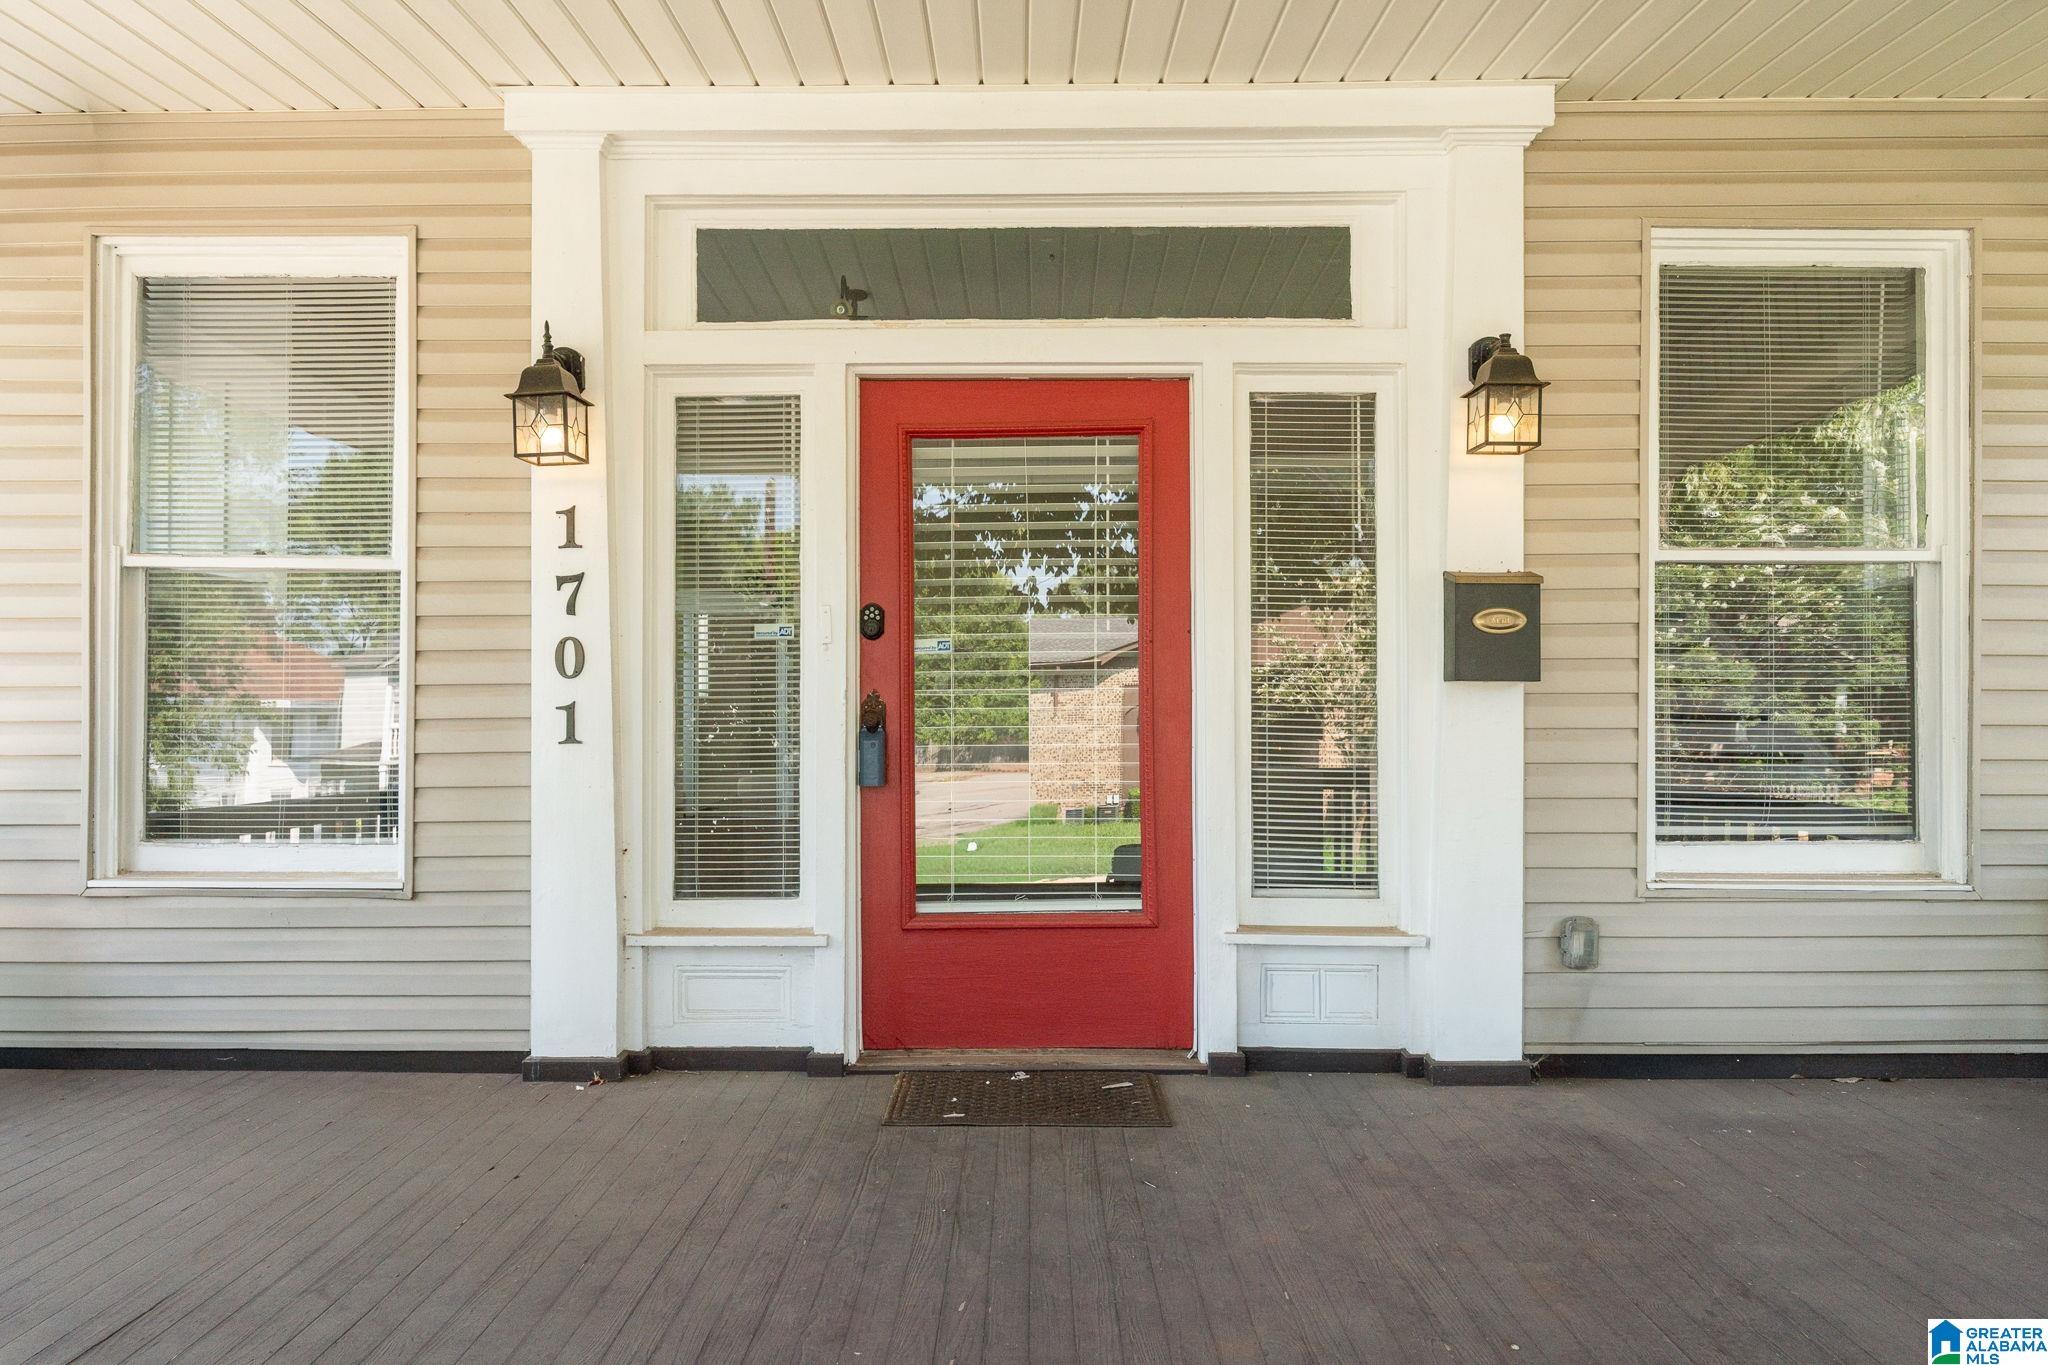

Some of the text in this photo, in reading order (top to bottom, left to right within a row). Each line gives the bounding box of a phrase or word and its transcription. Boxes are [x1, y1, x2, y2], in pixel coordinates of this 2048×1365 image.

[555, 505, 585, 745] 1701
[779, 627, 792, 636] ADT
[938, 641, 950, 650] ADT
